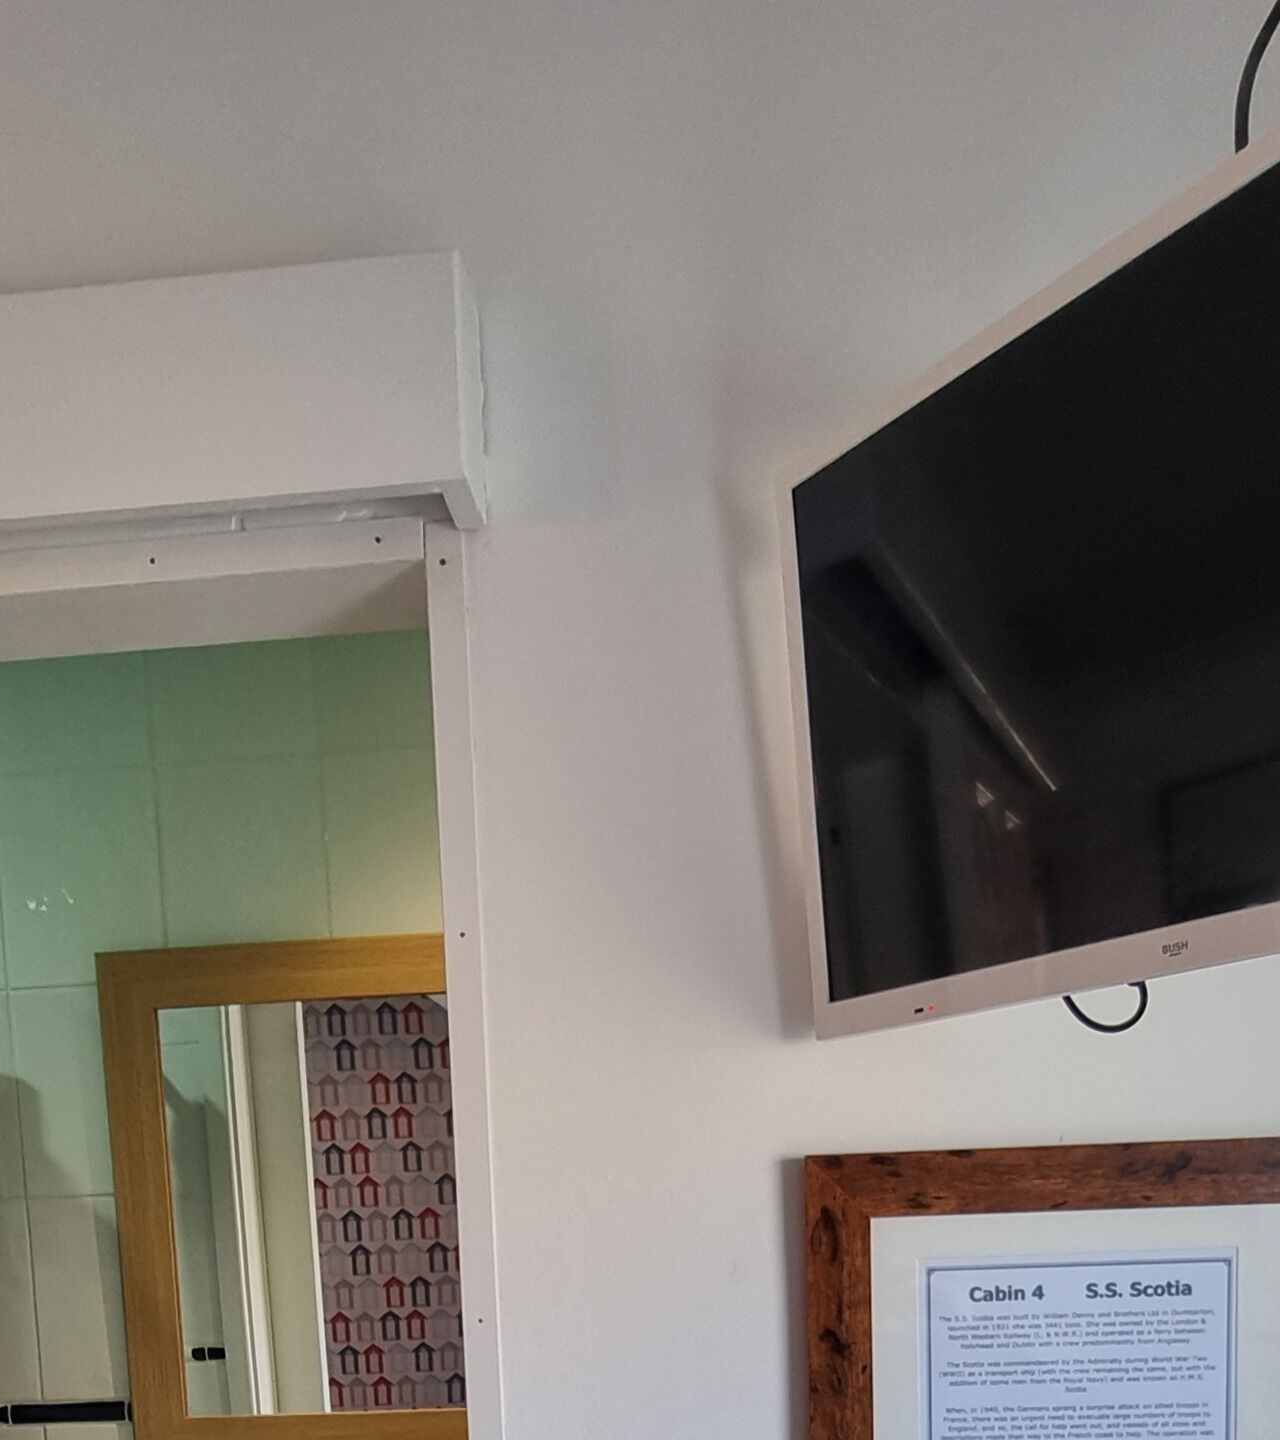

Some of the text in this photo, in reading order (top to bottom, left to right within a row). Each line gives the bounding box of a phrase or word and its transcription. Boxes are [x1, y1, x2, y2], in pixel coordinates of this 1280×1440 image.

[1161, 939, 1189, 955] BUSH
[969, 1279, 1193, 1303] Cabin 4 S.S. Scotia
[1020, 1368, 1035, 1376] ship
